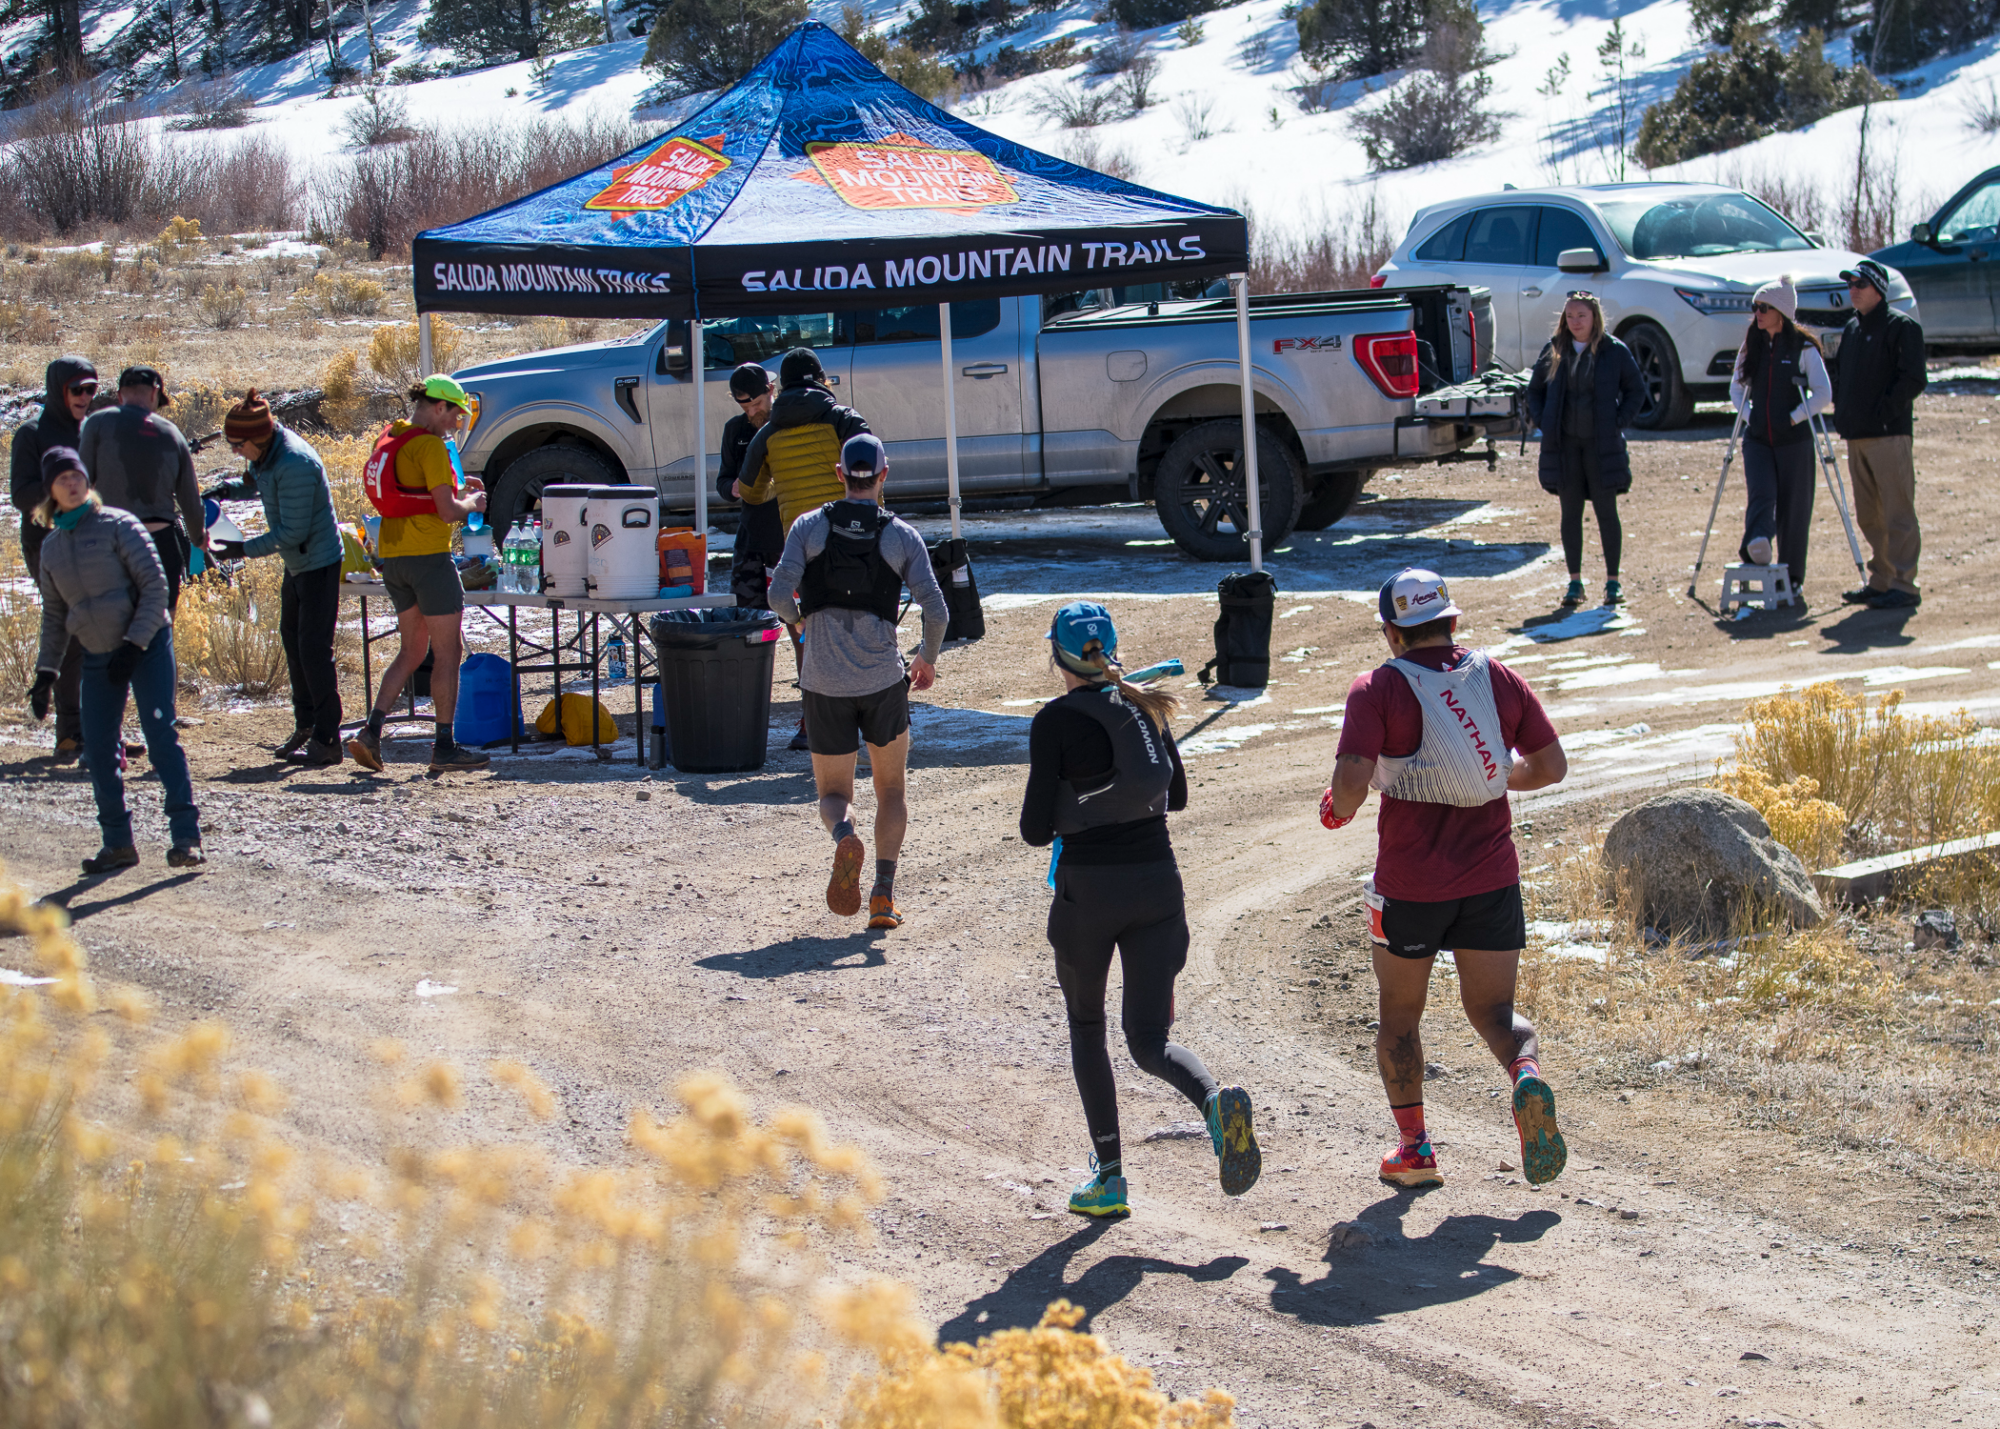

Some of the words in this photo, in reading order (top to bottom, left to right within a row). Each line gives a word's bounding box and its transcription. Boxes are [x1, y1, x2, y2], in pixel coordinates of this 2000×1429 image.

[660, 147, 714, 175] SALIDA
[856, 150, 971, 172] SALIDA
[624, 164, 703, 191] MOUNTAIN
[836, 168, 998, 187] MOUNTAIN
[617, 185, 675, 205] TRAILS
[882, 186, 989, 203] TRAILS
[741, 263, 877, 292] SALIDA
[885, 244, 1072, 288] MOUNTAIN
[1081, 235, 1207, 269] TRAILS
[434, 263, 500, 292] SALIDA
[500, 264, 600, 293] MOUNTAIN
[596, 268, 671, 294] TRAILS
[1273, 335, 1342, 355] FX4
[366, 461, 379, 486] 324
[1122, 700, 1159, 764] SALOMON
[1440, 689, 1497, 781] NATHAN
